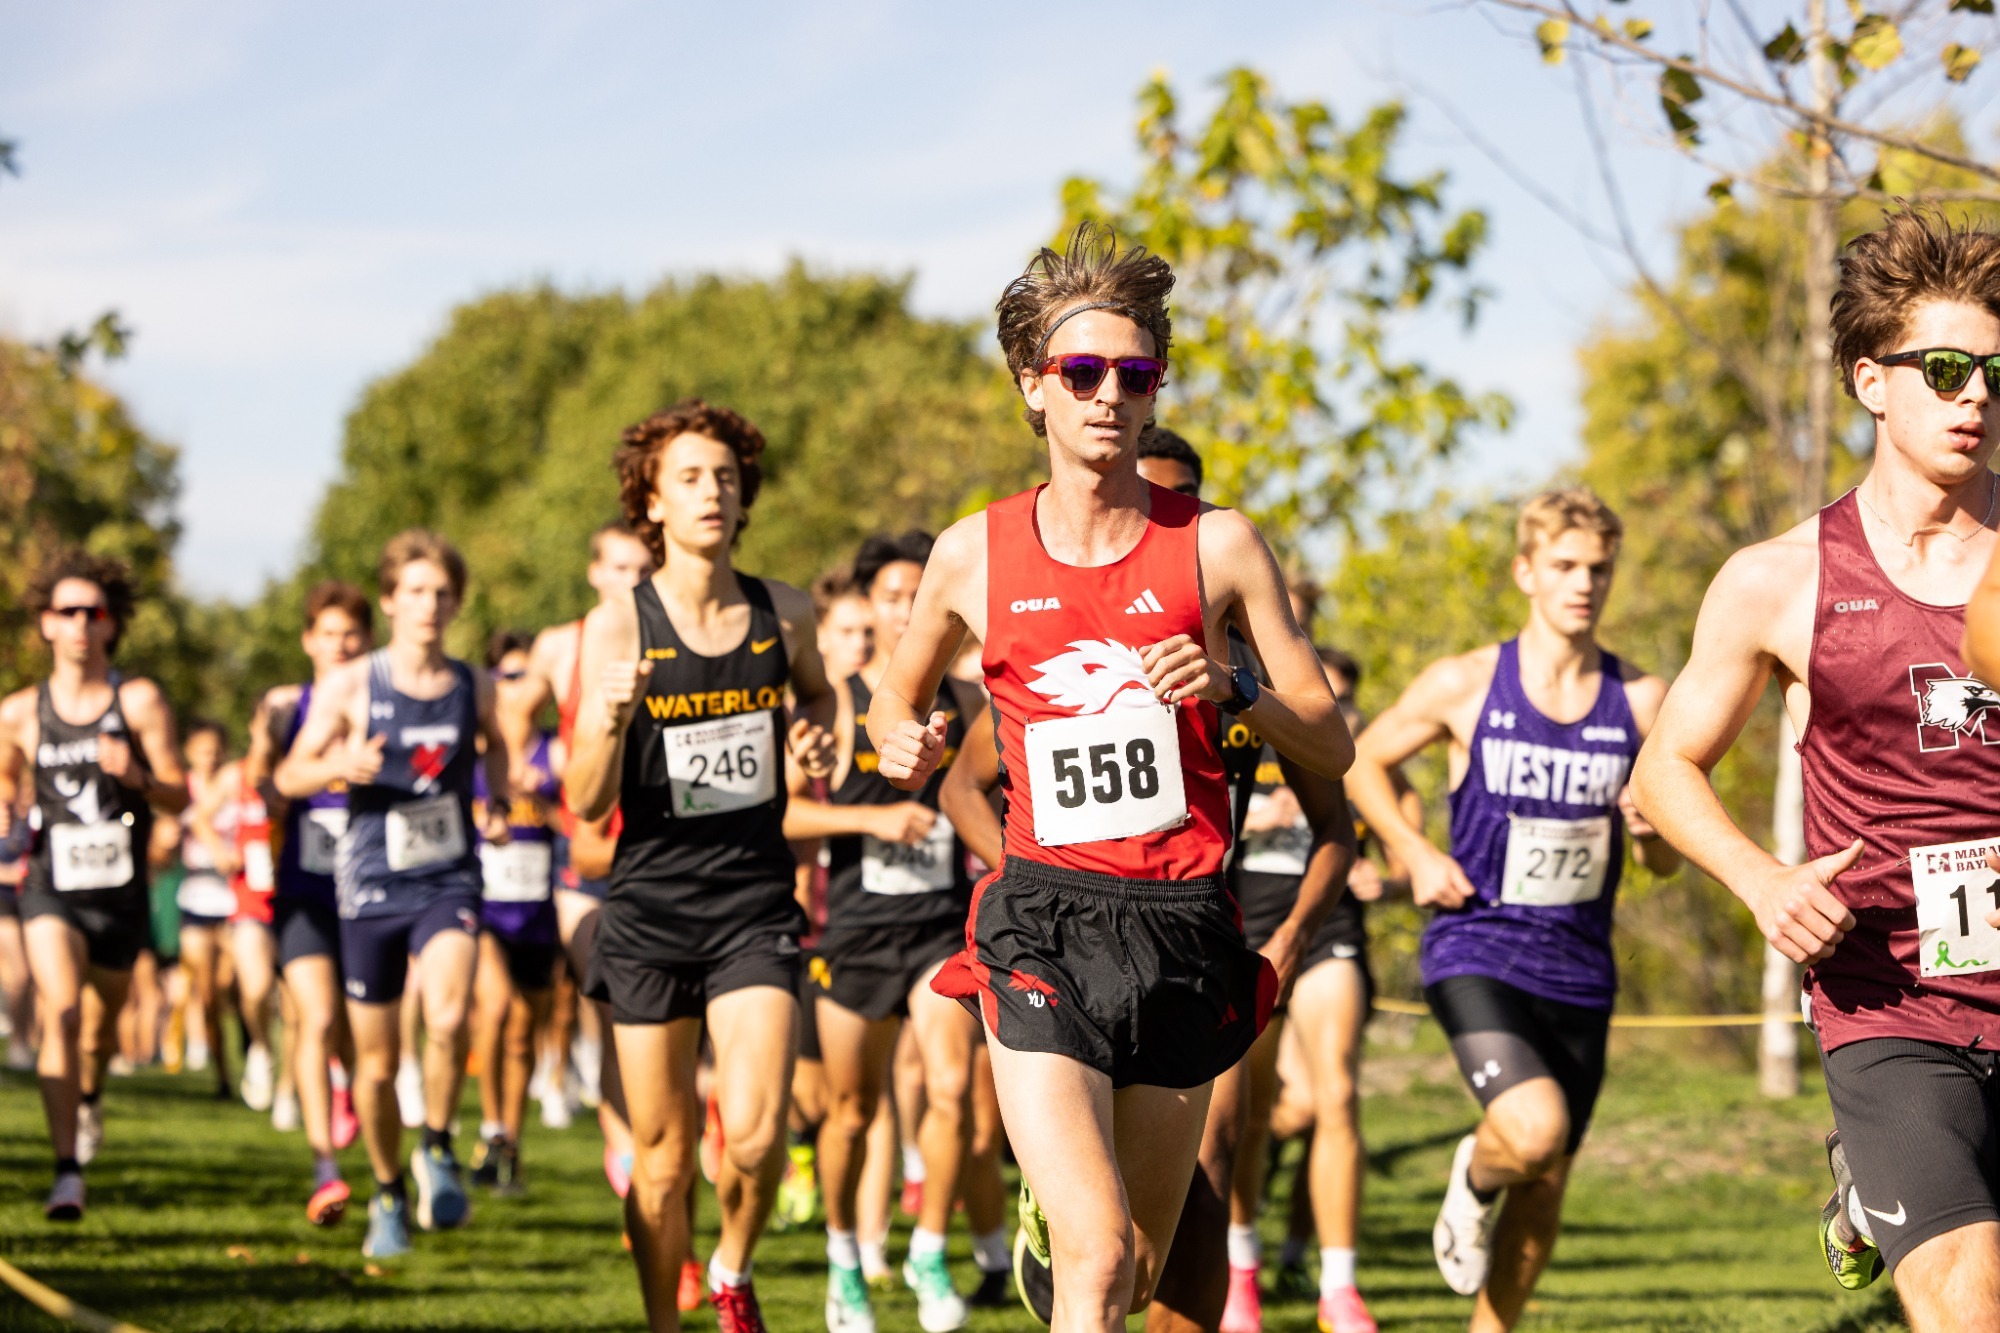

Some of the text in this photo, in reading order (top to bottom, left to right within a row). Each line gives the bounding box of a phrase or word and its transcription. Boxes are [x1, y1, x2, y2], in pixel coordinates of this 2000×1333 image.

[1009, 598, 1062, 614] OUA
[1834, 599, 1879, 613] OUA
[689, 745, 758, 788] 246
[1052, 738, 1160, 809] 558
[1481, 737, 1631, 808] WESTERN
[1526, 847, 1592, 879] 272
